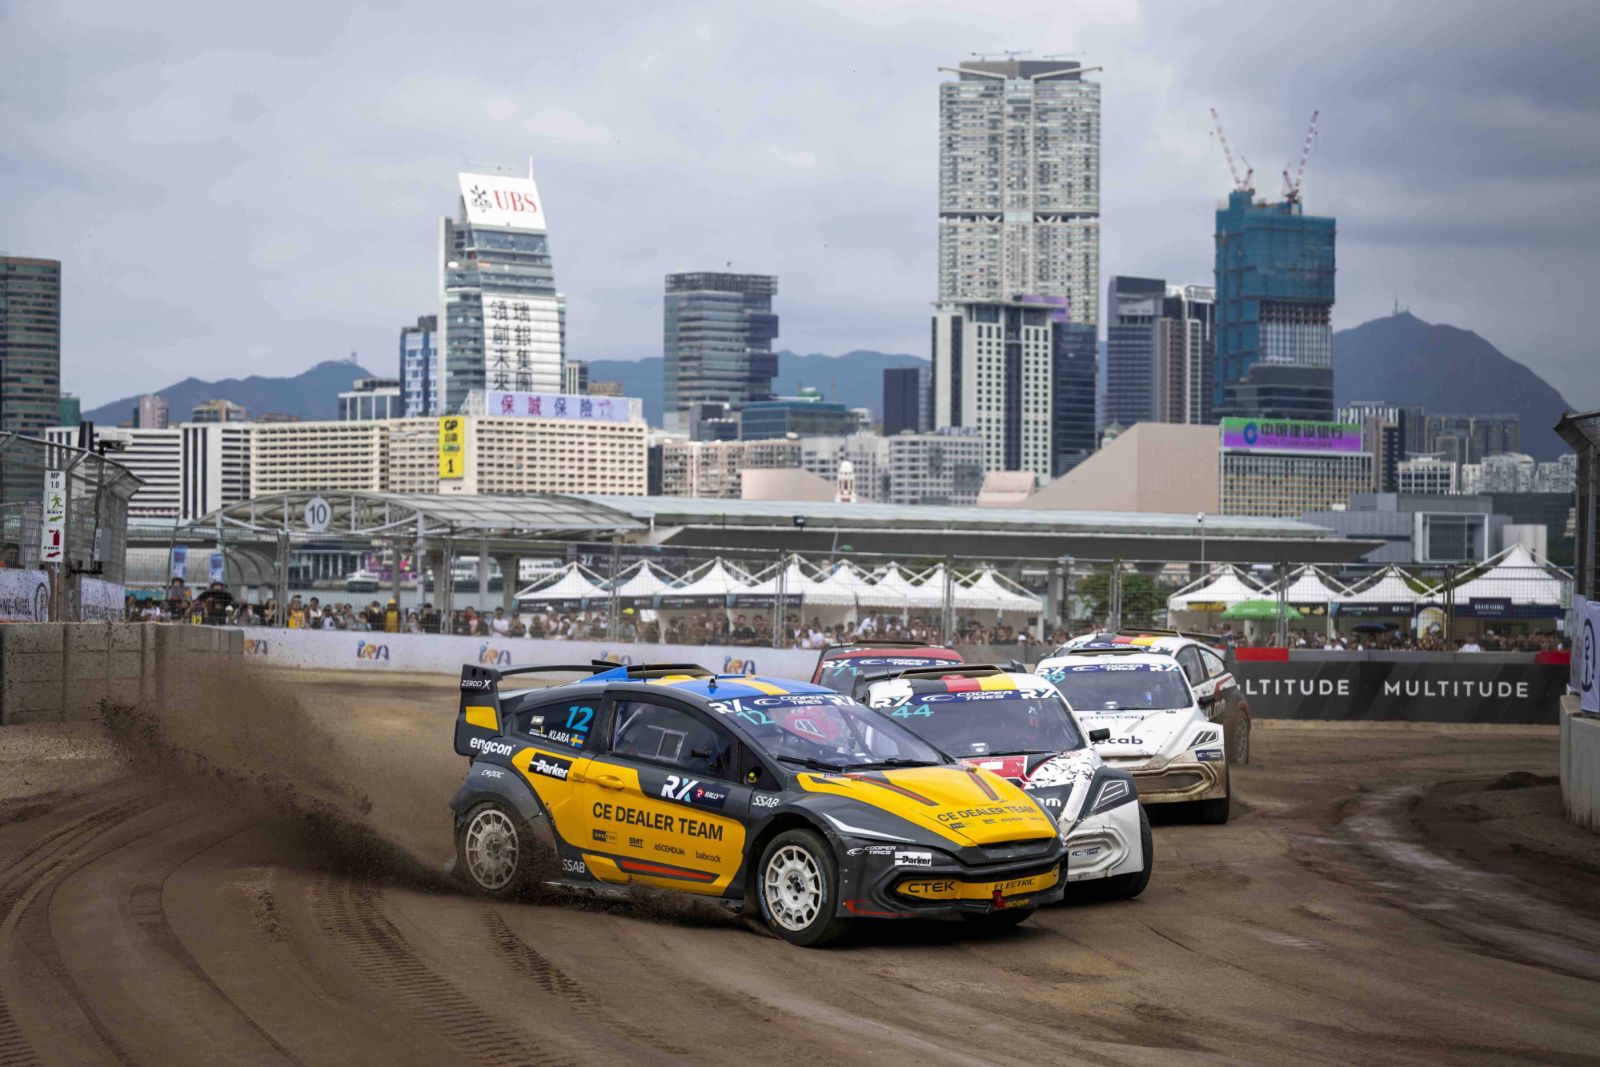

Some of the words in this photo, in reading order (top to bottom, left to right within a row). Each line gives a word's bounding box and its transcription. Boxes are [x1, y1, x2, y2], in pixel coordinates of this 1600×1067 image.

[494, 190, 537, 213] UBS
[444, 420, 458, 431] GP
[447, 459, 454, 473] 1
[308, 504, 327, 525] 10
[1019, 688, 1060, 699] RX
[1384, 680, 1528, 698] MULTITUDE
[708, 699, 752, 714] RX
[875, 695, 913, 708] RX
[736, 710, 775, 725] 12
[890, 703, 934, 718] 44
[566, 705, 593, 733] 12
[548, 729, 570, 744] KLARA
[470, 737, 513, 756] engcon
[535, 759, 569, 778] Parker
[661, 775, 699, 802] RX
[704, 791, 720, 800] RALLY
[752, 795, 780, 808] SSAB
[937, 812, 959, 822] CE
[957, 807, 1007, 819] DEALER
[1004, 805, 1037, 813] TEAM
[592, 802, 612, 820] CE
[615, 806, 674, 832] DEALER
[678, 818, 723, 842] TEAM
[629, 837, 644, 847] SMT
[654, 843, 686, 856] ASCENDUM
[695, 851, 721, 863] babcock
[562, 858, 585, 874] SSAB
[902, 855, 931, 865] Parker
[908, 881, 955, 894] CTEK
[993, 878, 1036, 890] ELECTRIC
